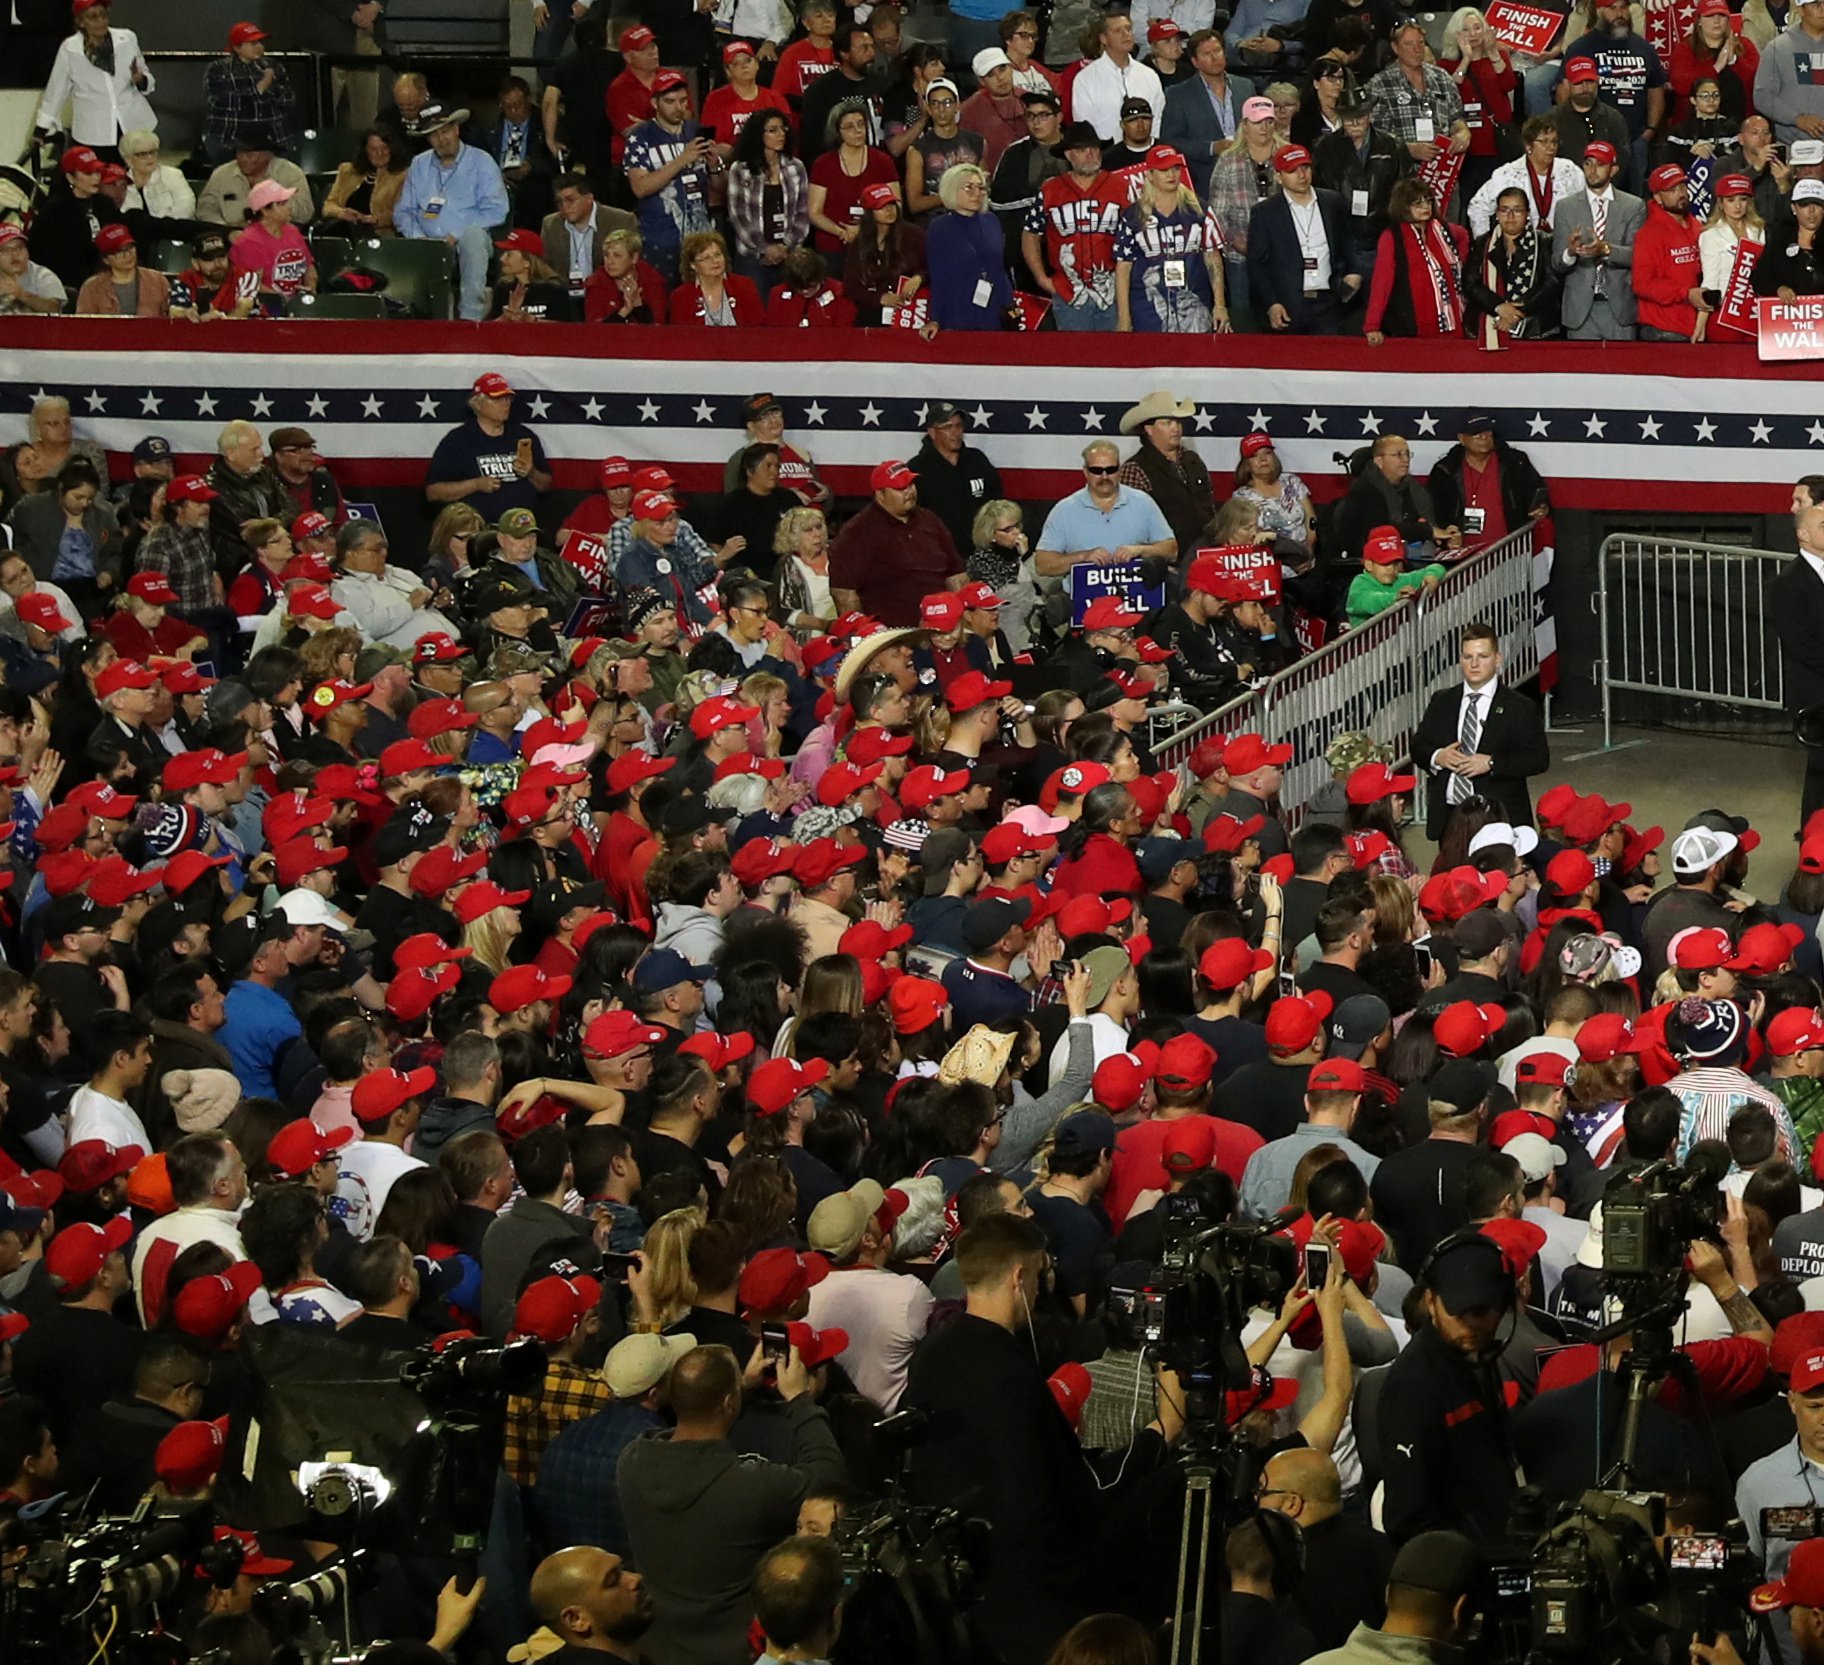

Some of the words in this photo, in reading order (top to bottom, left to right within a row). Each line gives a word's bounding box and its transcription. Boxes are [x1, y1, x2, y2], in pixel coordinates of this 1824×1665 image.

[1496, 6, 1551, 29] FINISH
[1509, 22, 1525, 33] THE
[1595, 53, 1645, 69] Trump
[1049, 198, 1121, 237] USA
[1134, 221, 1204, 258] USA
[1728, 251, 1756, 317] FINISH
[1792, 321, 1815, 331] THE
